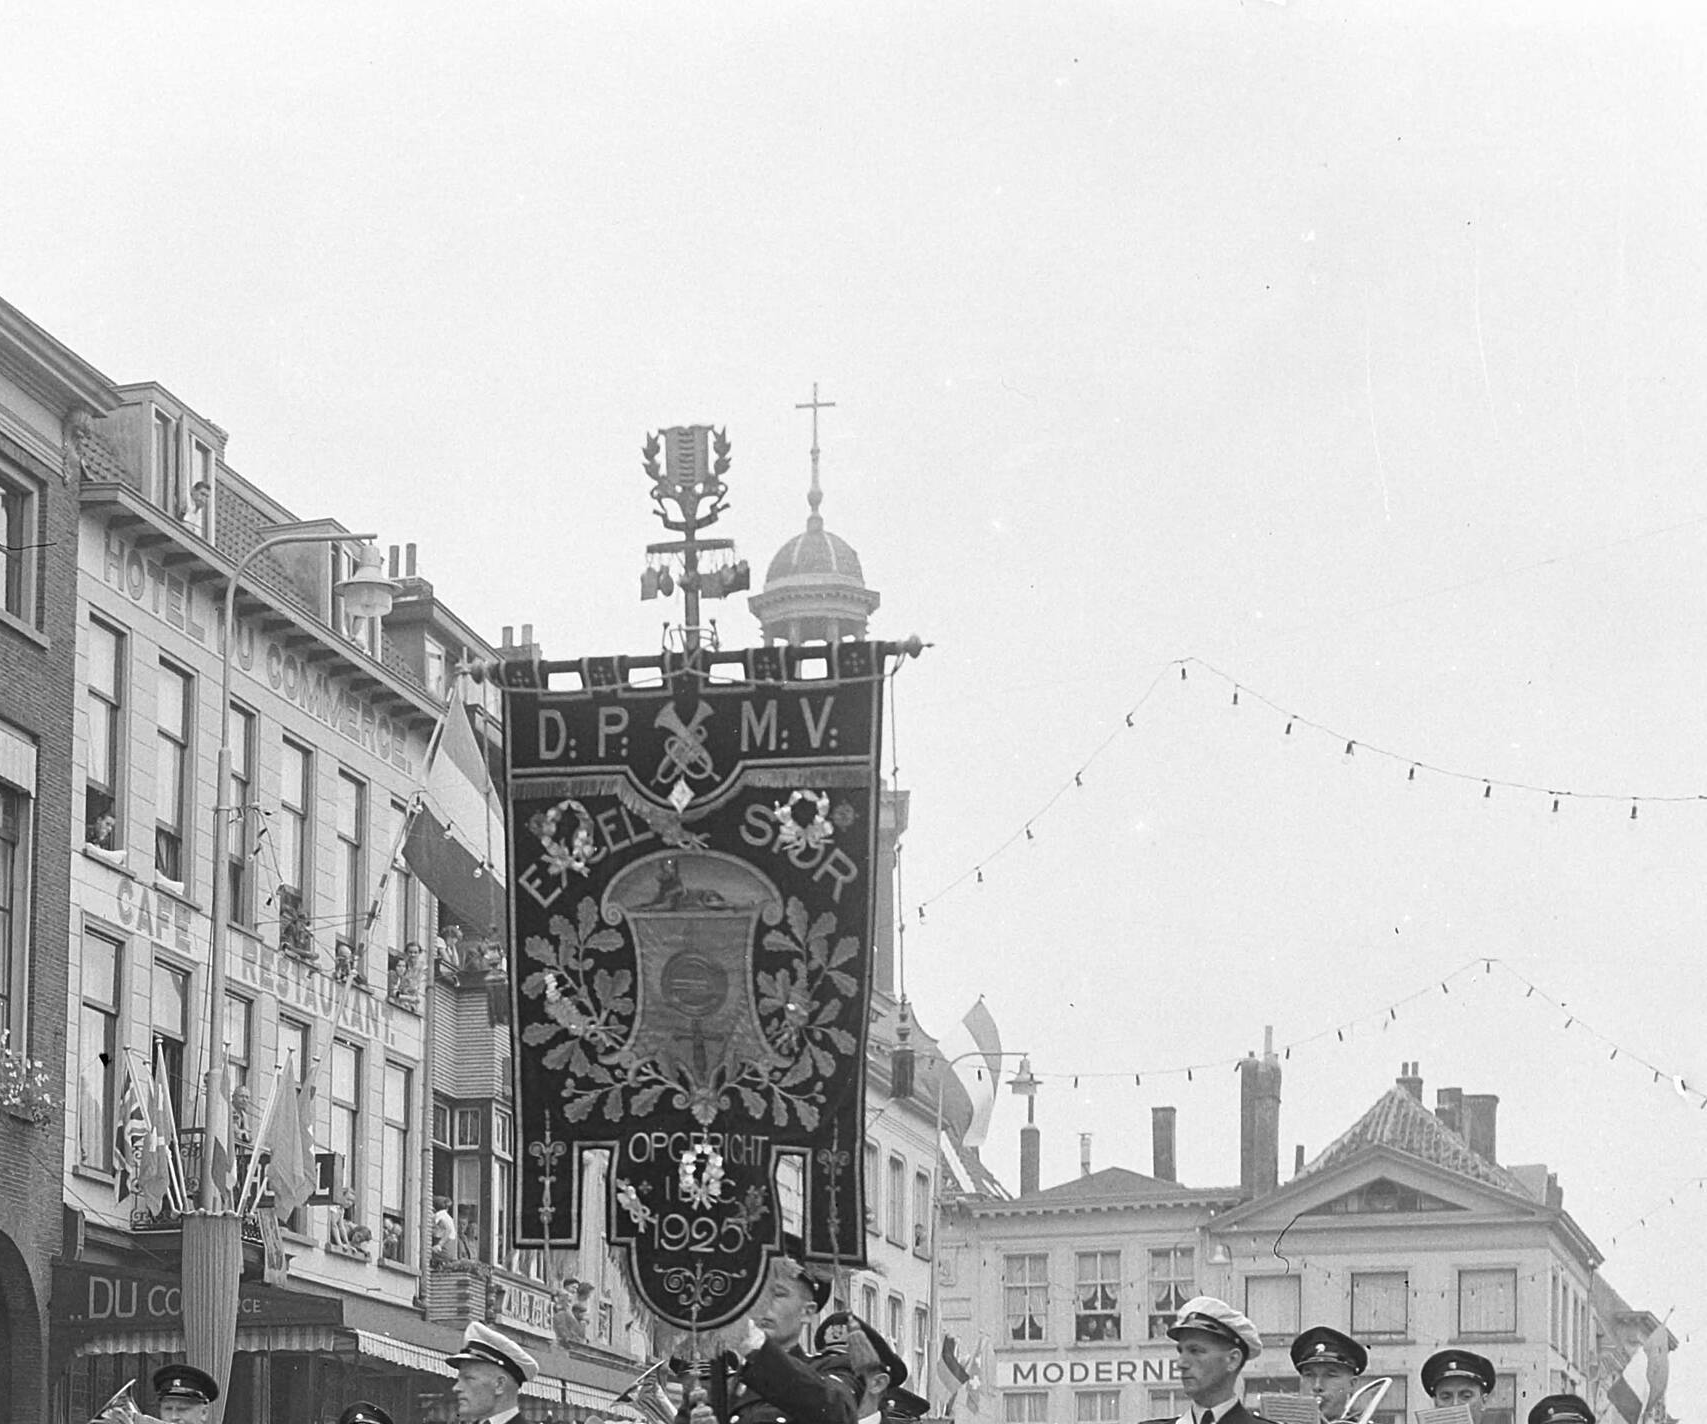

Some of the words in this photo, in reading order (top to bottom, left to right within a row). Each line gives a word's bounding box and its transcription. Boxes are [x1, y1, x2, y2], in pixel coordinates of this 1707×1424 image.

[103, 528, 206, 645] HOTEL
[216, 605, 255, 672] DU
[652, 1212, 744, 1253] 1925
[1012, 1359, 1182, 1385] MODERNE
